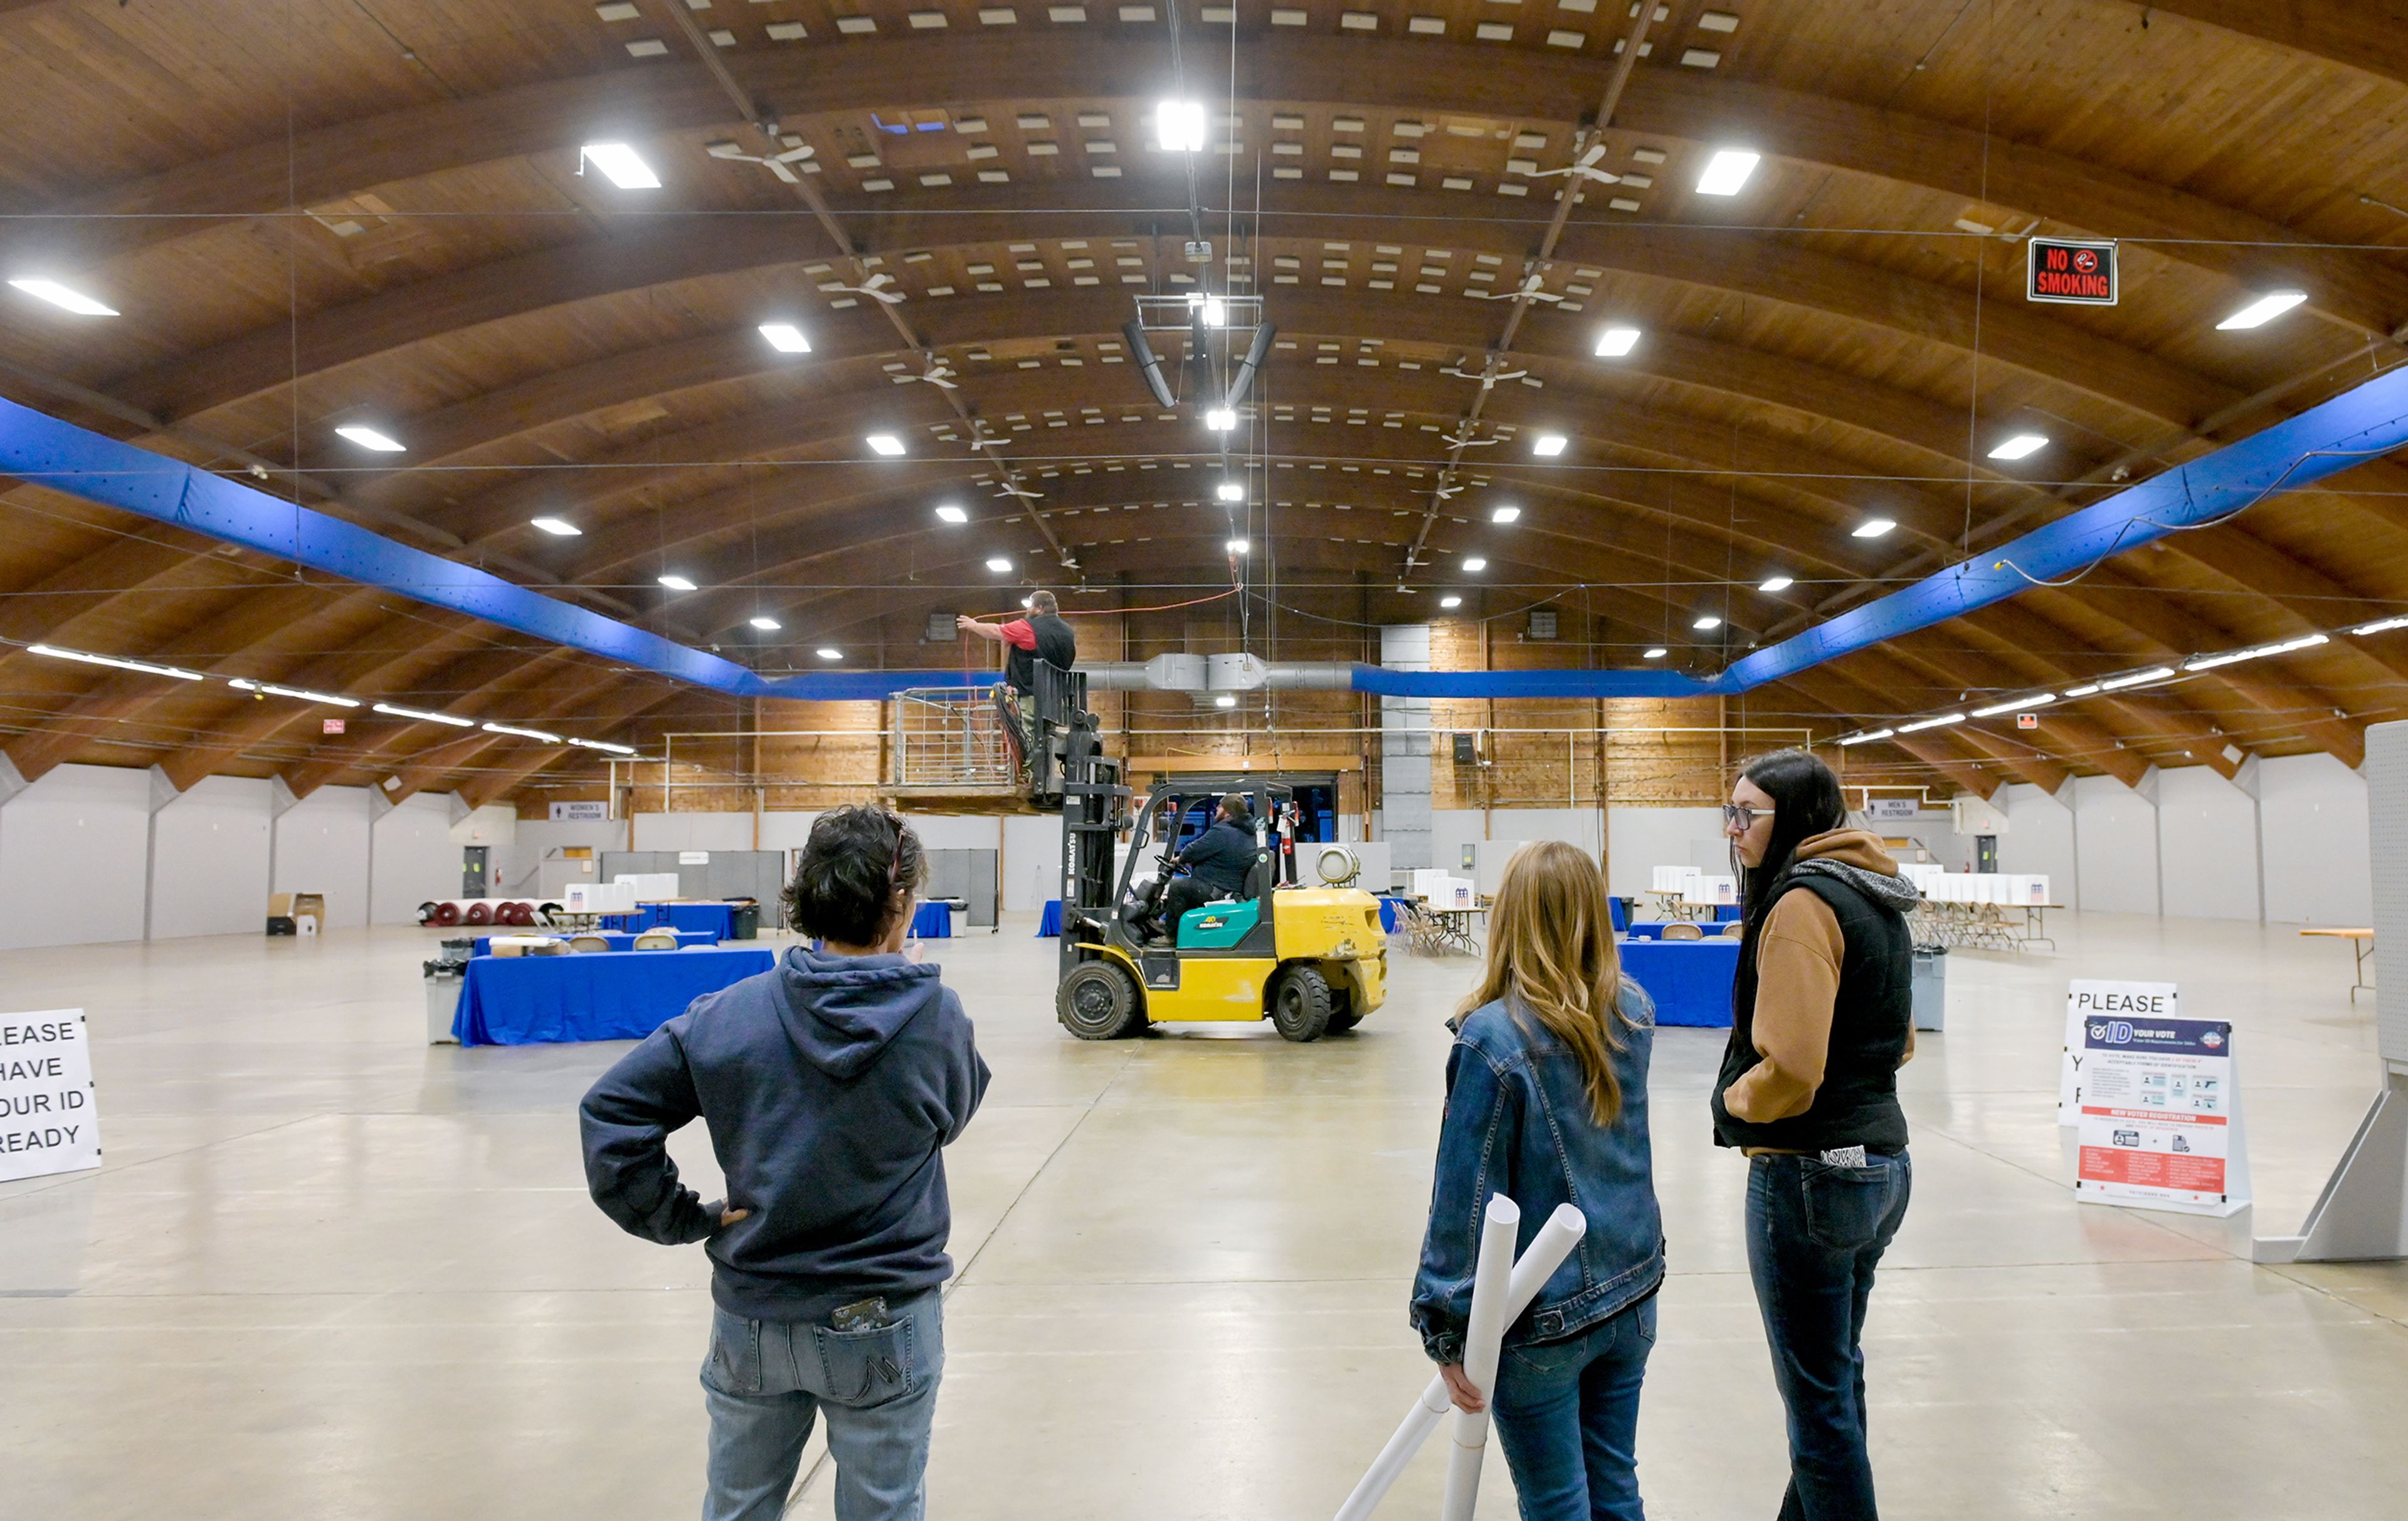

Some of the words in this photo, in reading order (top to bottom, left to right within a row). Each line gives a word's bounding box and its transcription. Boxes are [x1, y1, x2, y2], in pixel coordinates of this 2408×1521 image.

[2047, 248, 2068, 271] NO
[2038, 271, 2108, 297] SMOKING
[1068, 833, 1076, 875] KOMATSU
[2078, 994, 2164, 1012] PLEASE
[0, 1022, 75, 1046] EASE
[2105, 1021, 2133, 1044] ID
[2133, 1029, 2155, 1038] YOUR
[2155, 1031, 2176, 1039] VOTE
[60, 1090, 84, 1110] ID
[2127, 1110, 2148, 1118] VOTER
[2148, 1111, 2197, 1121] REGISTRATION
